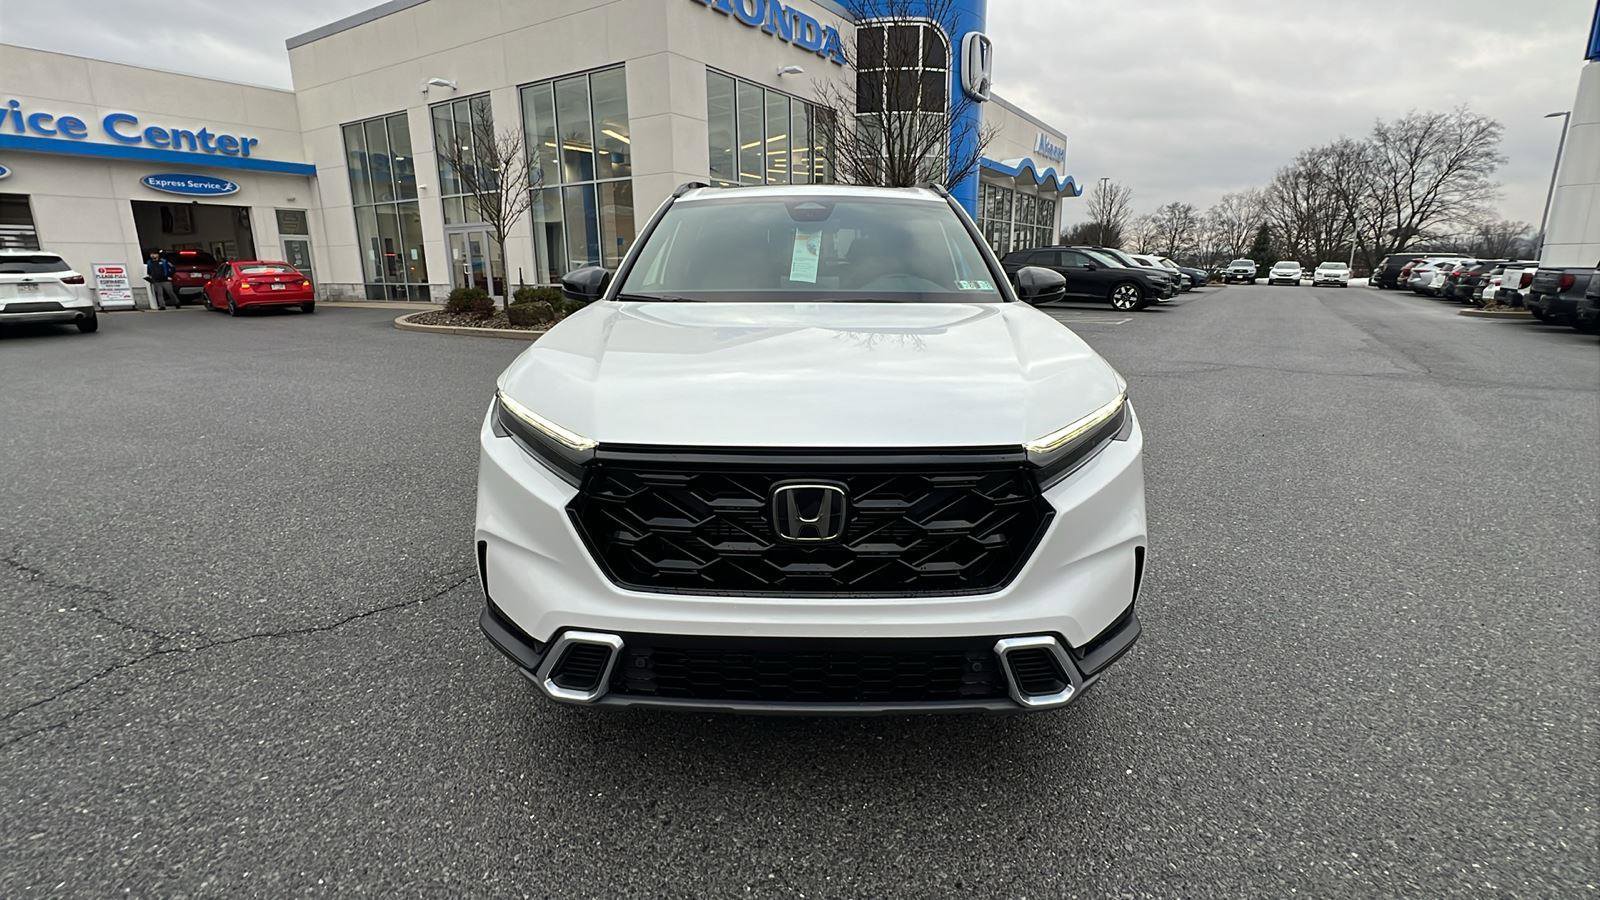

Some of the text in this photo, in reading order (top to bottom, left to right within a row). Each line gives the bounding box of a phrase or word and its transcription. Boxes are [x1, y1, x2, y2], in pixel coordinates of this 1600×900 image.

[690, 0, 847, 66] ONDA
[102, 112, 259, 157] Center
[148, 177, 221, 190] Express Service
